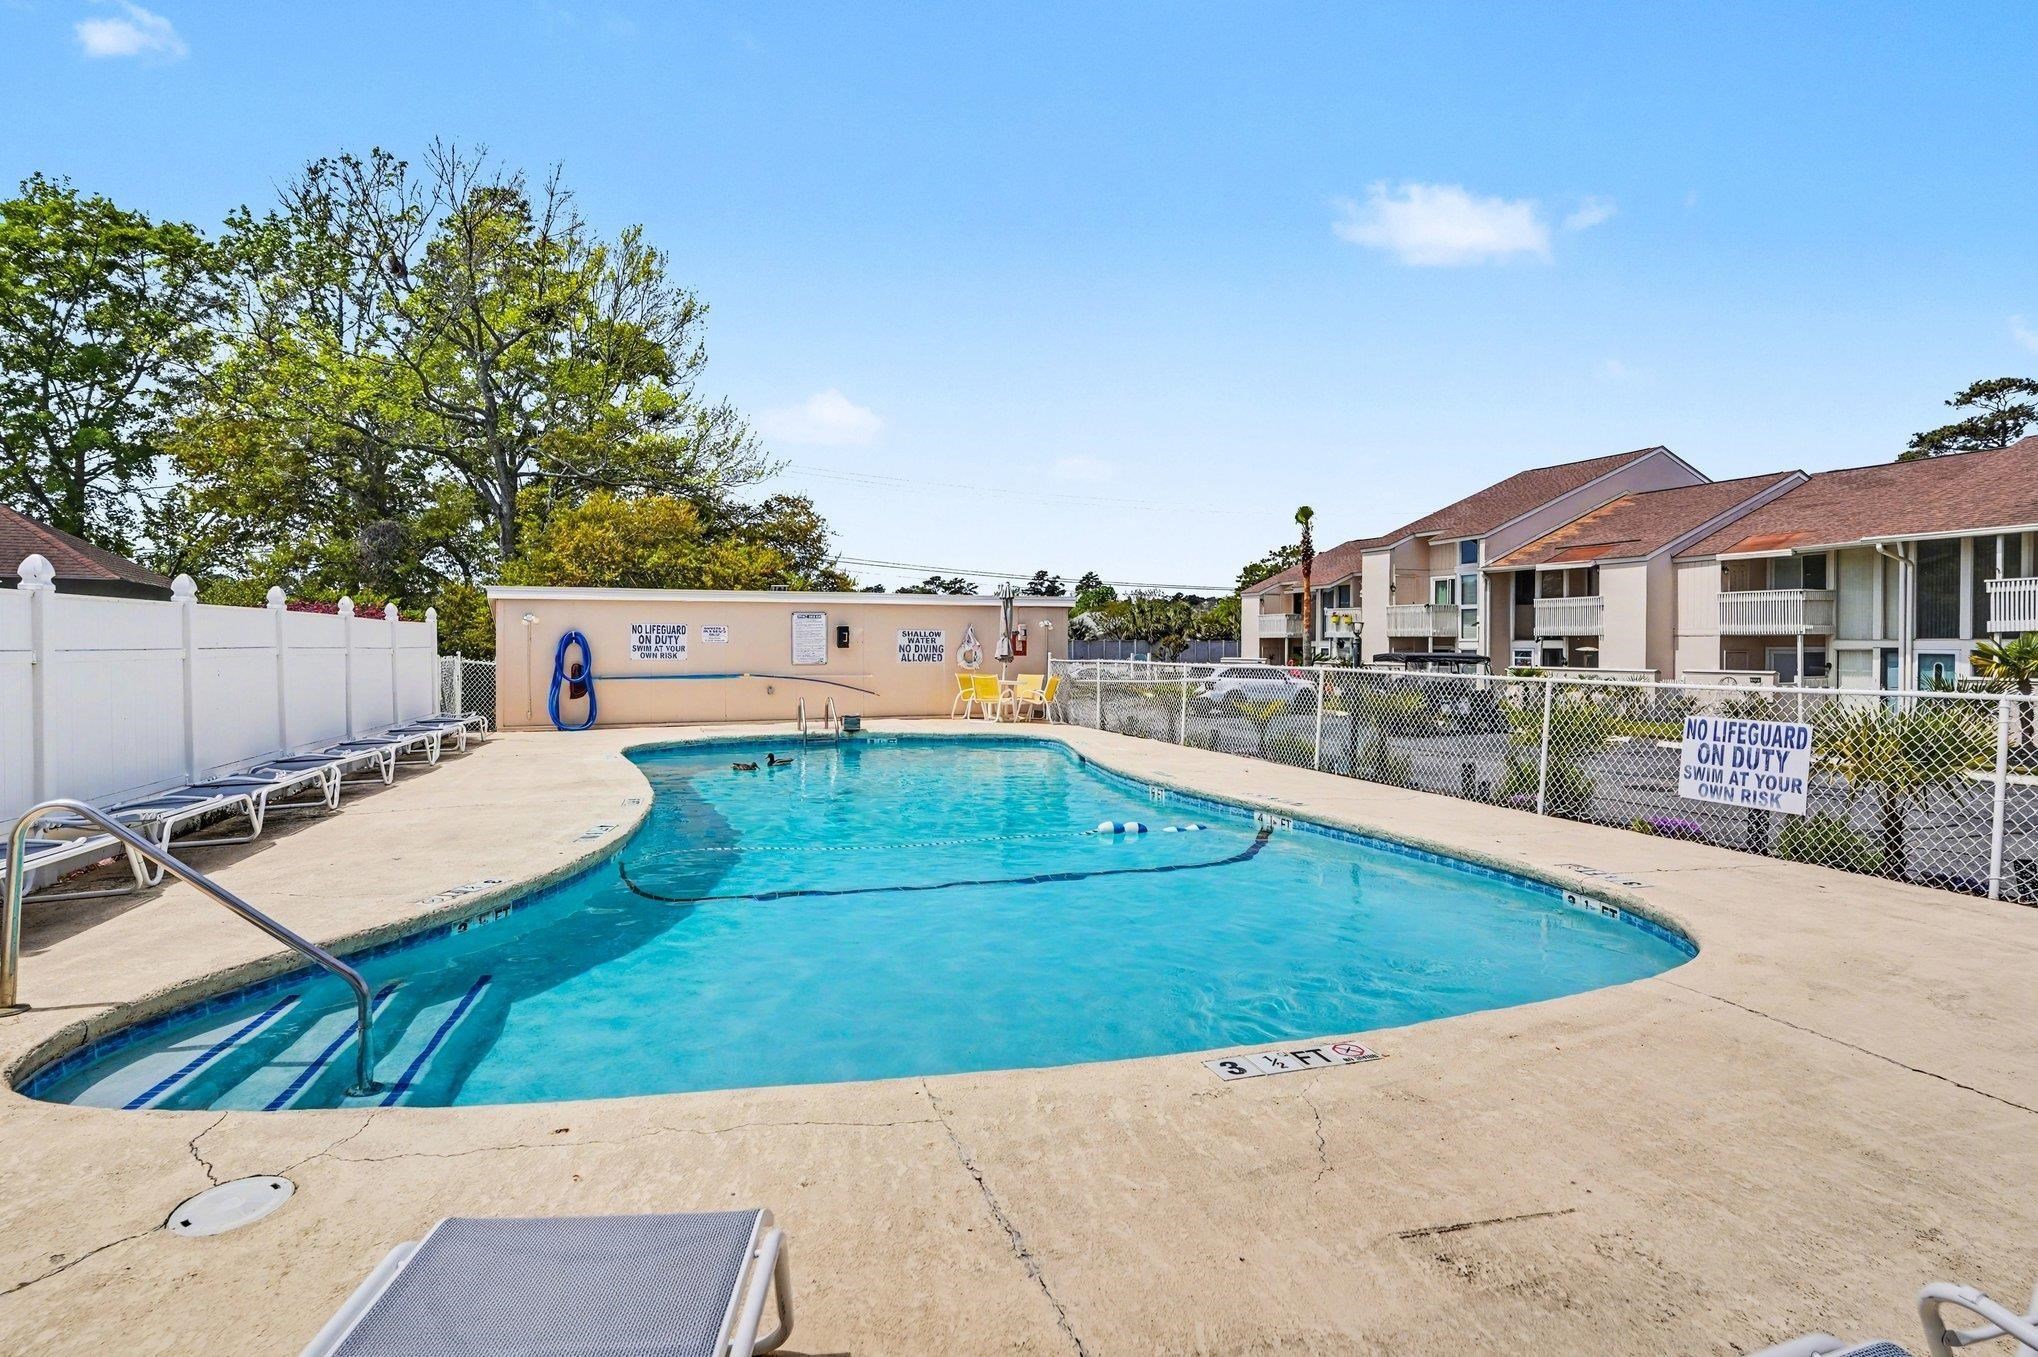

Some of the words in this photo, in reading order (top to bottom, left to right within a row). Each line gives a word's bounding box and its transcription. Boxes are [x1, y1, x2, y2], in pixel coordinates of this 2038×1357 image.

[631, 624, 643, 635] NO
[645, 624, 687, 635] LIFEGUARD
[638, 635, 652, 645] ON
[655, 635, 680, 645] DUTY
[899, 645, 911, 653] NO
[914, 645, 944, 653] DIVING
[901, 653, 942, 662] ALLOWED
[1686, 718, 1708, 741] NO
[1713, 720, 1808, 750] LIFEGUARD
[1697, 742, 1725, 767] ON
[1732, 745, 1790, 773] DUTY
[1683, 764, 1724, 784] SWIM
[1728, 770, 1749, 787] AT
[1755, 773, 1803, 794] YOUR
[1698, 783, 1735, 802] OWN
[1740, 789, 1783, 809] RISK
[1219, 1061, 1247, 1075] 3
[1289, 1049, 1332, 1066] FT
